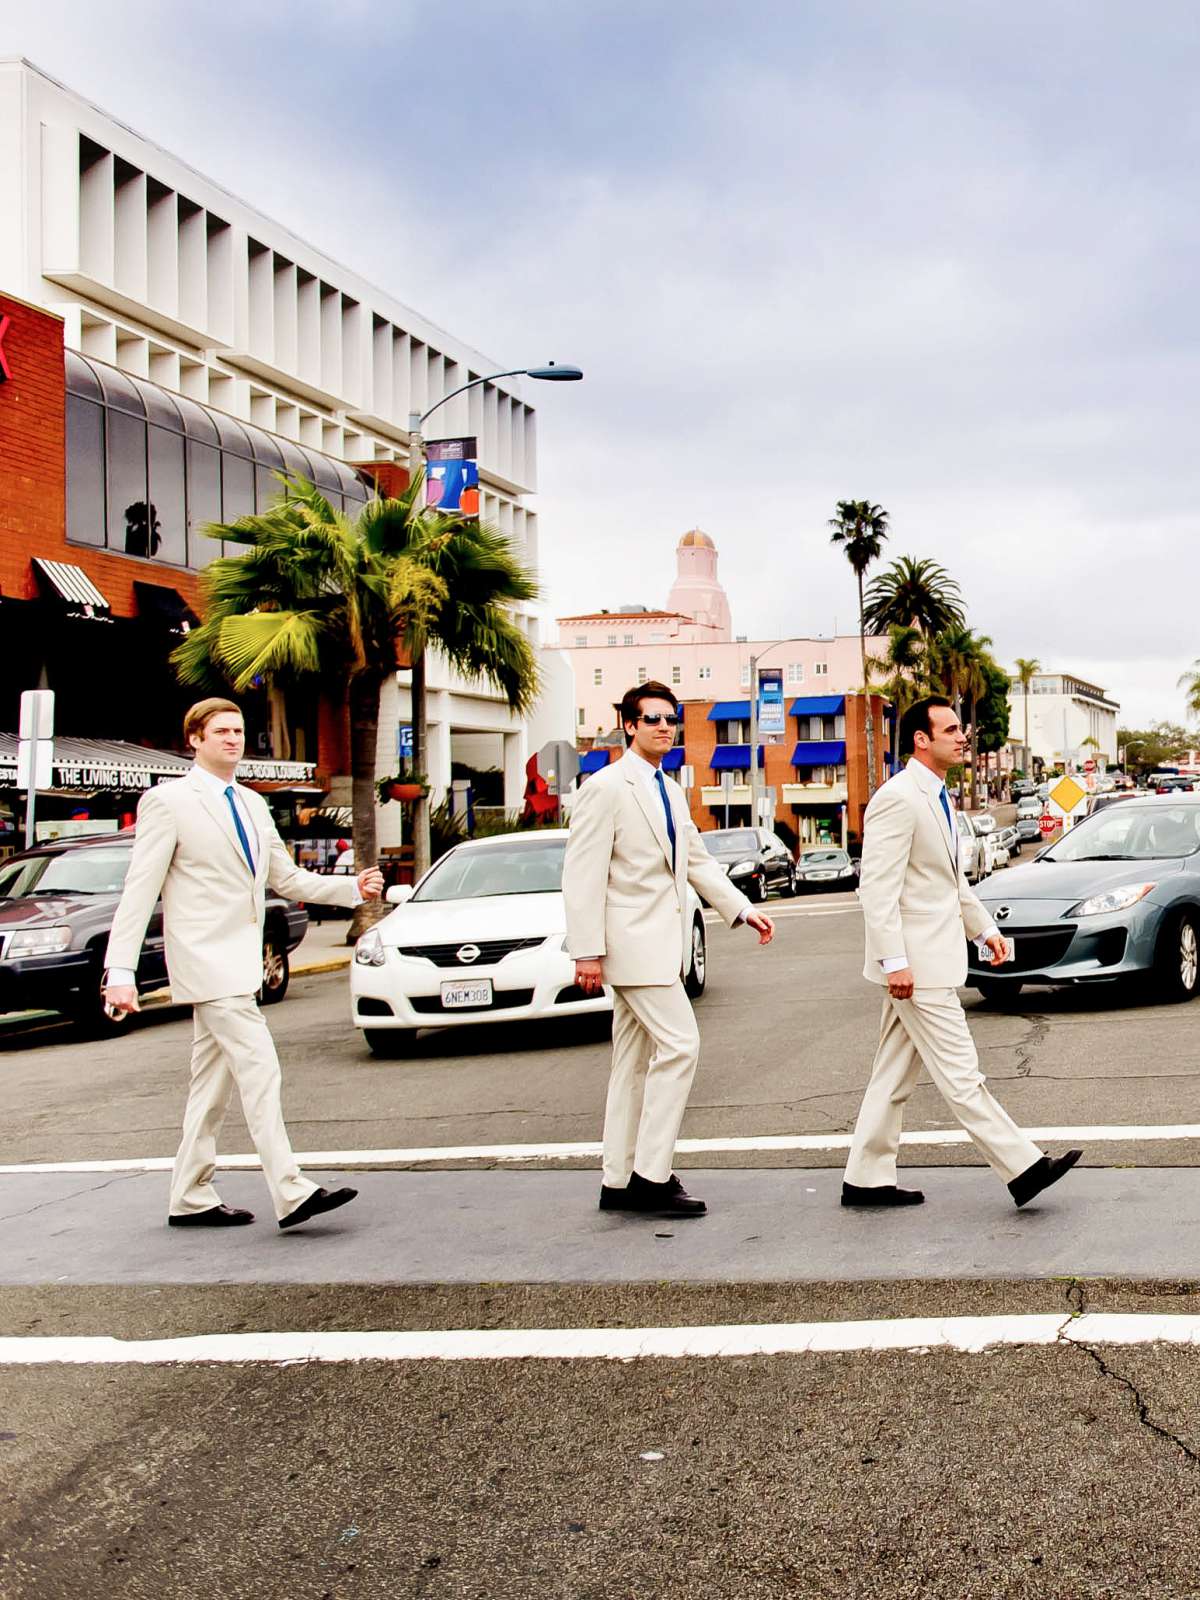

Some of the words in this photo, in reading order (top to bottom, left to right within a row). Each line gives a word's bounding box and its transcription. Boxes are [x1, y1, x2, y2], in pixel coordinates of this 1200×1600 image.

[58, 768, 81, 785] THE
[83, 768, 117, 787] LIVING
[120, 769, 152, 788] ROOM
[1040, 820, 1056, 828] STOP
